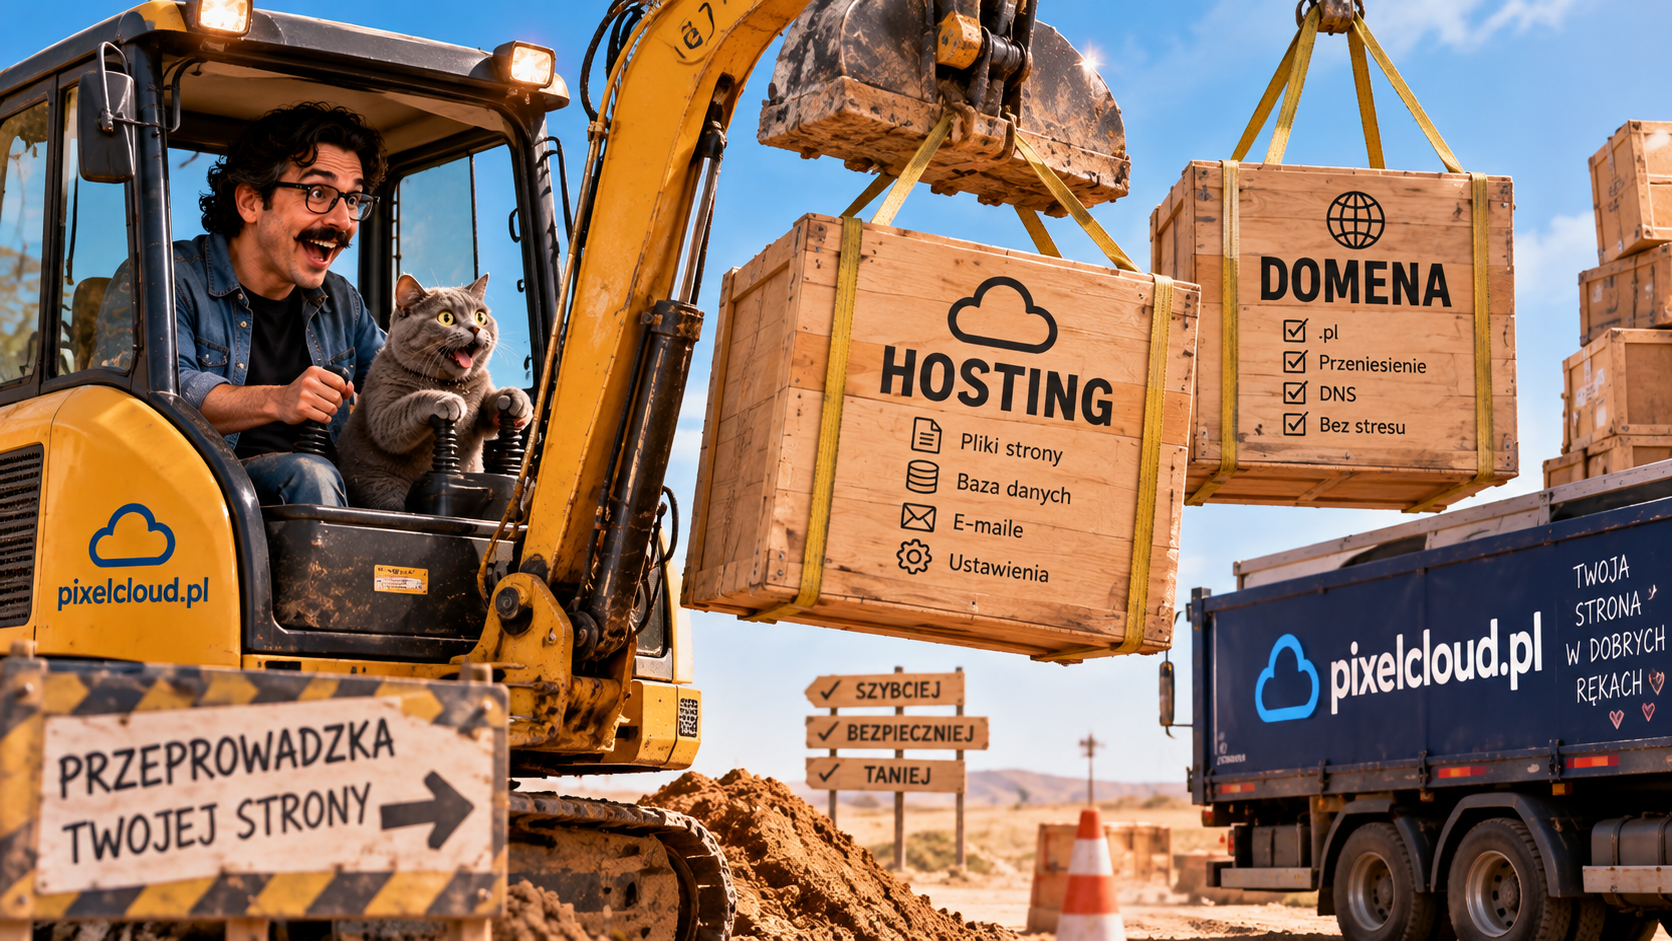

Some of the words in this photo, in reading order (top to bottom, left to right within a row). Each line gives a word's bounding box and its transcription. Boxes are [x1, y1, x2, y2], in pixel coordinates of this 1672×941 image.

[1261, 256, 1452, 307] DOMENA
[1318, 323, 1339, 344] .pl
[1319, 354, 1427, 374] Przeniesienie
[880, 345, 1113, 427] HOSTING
[1320, 385, 1357, 403] DNS
[1320, 416, 1350, 434] Bez
[1355, 418, 1406, 435] stresu
[960, 432, 999, 454] Pliki
[1005, 441, 1063, 467] strony
[956, 472, 1000, 495] Baza
[1006, 479, 1071, 506] danych
[953, 513, 1024, 539] E-maile
[949, 553, 1049, 583] Ustawienia
[1572, 554, 1630, 588] TWOJA
[57, 576, 209, 611] pixelcloud.pl
[1575, 590, 1642, 627] STRONA
[1565, 640, 1581, 666] W
[1589, 624, 1666, 663] DOBRYCH
[1330, 611, 1543, 715] pixelcloud.pl
[855, 680, 941, 700] SZYBCIEJ
[1576, 668, 1643, 706] RĘKACH
[847, 723, 975, 743] BEZPIECZNIEJ
[58, 716, 396, 800] PRZEPROWADZKA
[863, 765, 931, 786] TANIEJ
[61, 802, 218, 865] TWOJEJ
[236, 782, 372, 841] STRONY
